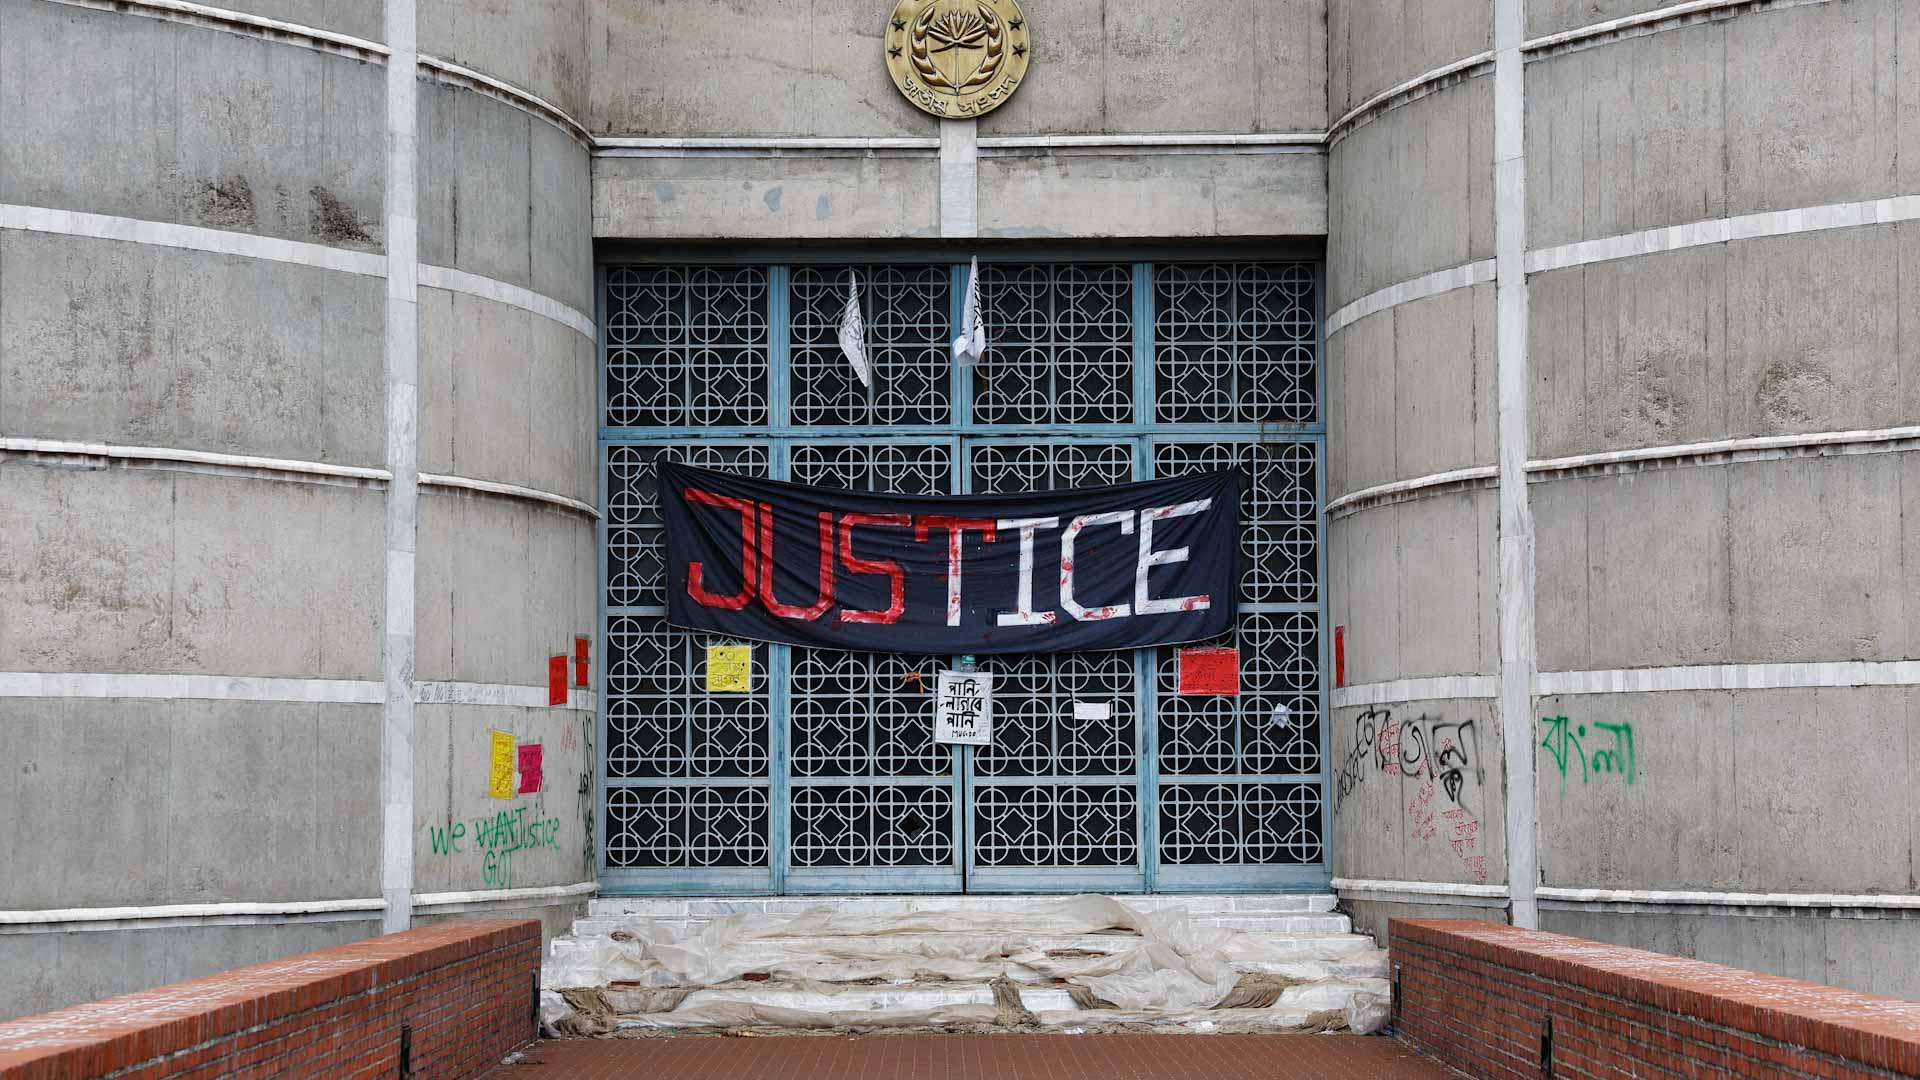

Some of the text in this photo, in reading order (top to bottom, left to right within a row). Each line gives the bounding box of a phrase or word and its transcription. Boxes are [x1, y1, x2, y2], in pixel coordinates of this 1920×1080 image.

[683, 487, 1213, 627] JUSTICE
[1542, 714, 1634, 785] বাংলা
[482, 849, 513, 889] GOT
